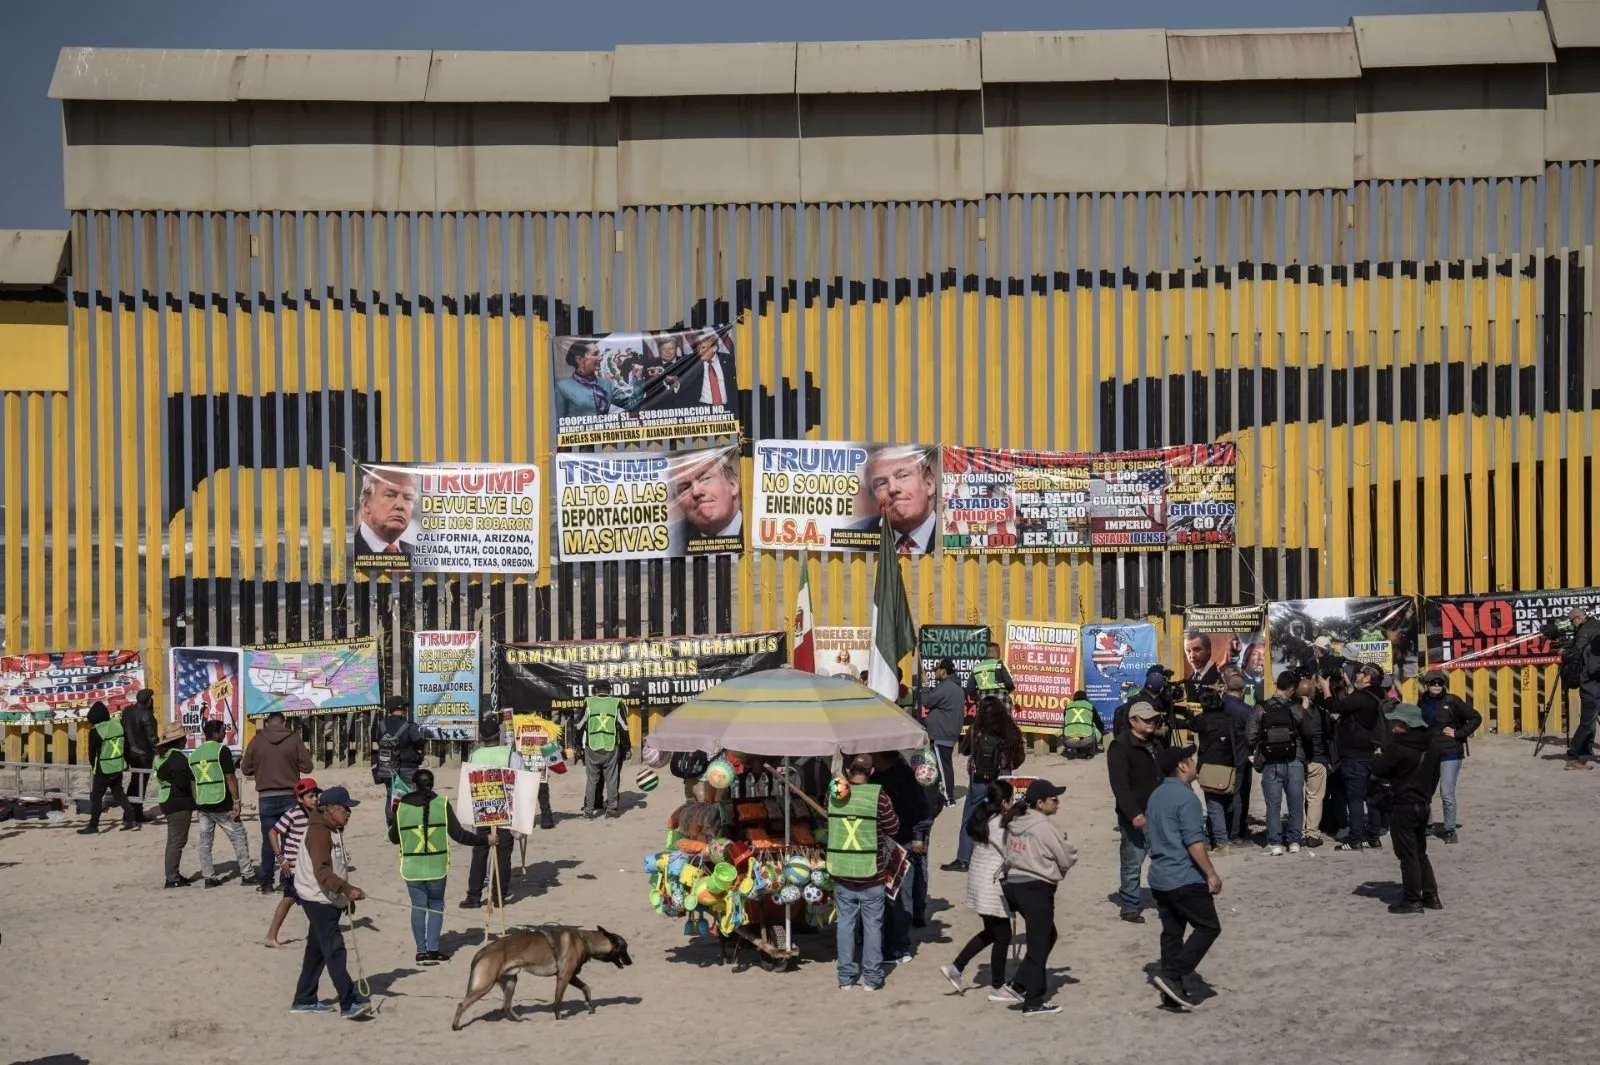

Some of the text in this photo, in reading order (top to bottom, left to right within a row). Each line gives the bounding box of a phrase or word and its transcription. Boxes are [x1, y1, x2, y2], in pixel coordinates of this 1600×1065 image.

[559, 413, 618, 426] COOPERACION
[639, 407, 712, 420] SUBORDINACION
[642, 419, 677, 427] SOBERANO
[685, 414, 735, 424] INDEPENDIENTE
[561, 422, 736, 444] ANGELES SIN FRONTERAS ALIANZA MIGRANTE TIJUANA
[758, 446, 867, 474] TRUMP
[1092, 460, 1161, 471] SEGUIR SIENDO
[560, 456, 670, 484] TRUMP
[1016, 468, 1089, 478] NO QUEREMOS
[418, 466, 536, 494] TRUMP
[944, 473, 1012, 484] INTROMISION
[1117, 472, 1138, 481] LOS
[762, 473, 860, 495] NO SOMOS
[1016, 479, 1089, 490] SEGUIR SIENDO
[1106, 483, 1149, 493] PERROS
[562, 482, 668, 507] ALTO A LAS
[969, 486, 987, 495] DE
[948, 498, 1009, 509] ESTADOS
[1021, 492, 1085, 503] EL PATIO
[1093, 495, 1162, 505] GUARDIANES
[421, 496, 533, 514] DEVUELVE LO
[766, 495, 853, 516] ENEMIGOS DE
[1170, 503, 1235, 516] GRINGOS
[562, 506, 668, 527] DEPORTACIONES
[953, 510, 1006, 522] UNIDOS
[1020, 507, 1086, 519] TRASERO
[1118, 508, 1139, 517] DEL
[421, 516, 533, 531] QUE NOS ROBARON
[970, 524, 987, 532] EN
[1046, 520, 1060, 530] DE
[1105, 520, 1152, 530] IMPERIO
[1194, 517, 1214, 528] GO
[760, 518, 826, 546] U.S.A.
[1092, 532, 1166, 544] ESTAUNIDENSE
[1177, 530, 1230, 543] HOME
[416, 533, 533, 545] CALIFORNIA, ARIZONA,
[563, 526, 669, 554] MASIVAS
[943, 534, 1016, 547] MEXICO
[1023, 532, 1084, 546] EE.UU.
[415, 545, 532, 556] NEVADA, UTAH, COLORADO,
[414, 557, 535, 568] NUEVO MEXICO, TEXAS, OREGON.
[1441, 600, 1514, 638] NO
[1516, 608, 1537, 620] DE
[1542, 606, 1572, 618] LOS
[418, 632, 476, 647] TRUMP
[922, 629, 987, 642] LEVANTATE
[1009, 626, 1078, 644] DONAL TRUMP
[419, 648, 474, 660] LOS MIGRANTES
[506, 636, 778, 664] CAMPAMENTO PARA MIGRANTES
[922, 643, 987, 657] MEXICANO
[1027, 652, 1046, 663] E.E.
[1050, 653, 1070, 664] U.U.
[419, 660, 474, 673] MEXICANOS,
[587, 659, 698, 679] DEPORTADOS
[52, 676, 88, 685] DE
[1024, 675, 1071, 685] ENEMIGOS ESTAN
[10, 679, 133, 696] ESTADOS
[419, 683, 474, 693] TRABAJADORES,
[648, 681, 669, 694] RIO
[1018, 685, 1036, 693] OTRAS
[19, 688, 125, 703] UNIDOS
[56, 700, 88, 709] EN
[552, 699, 584, 708] Angeles
[648, 696, 670, 704] Plaza
[183, 712, 199, 724] día
[1027, 711, 1064, 721] CONFUNDA
